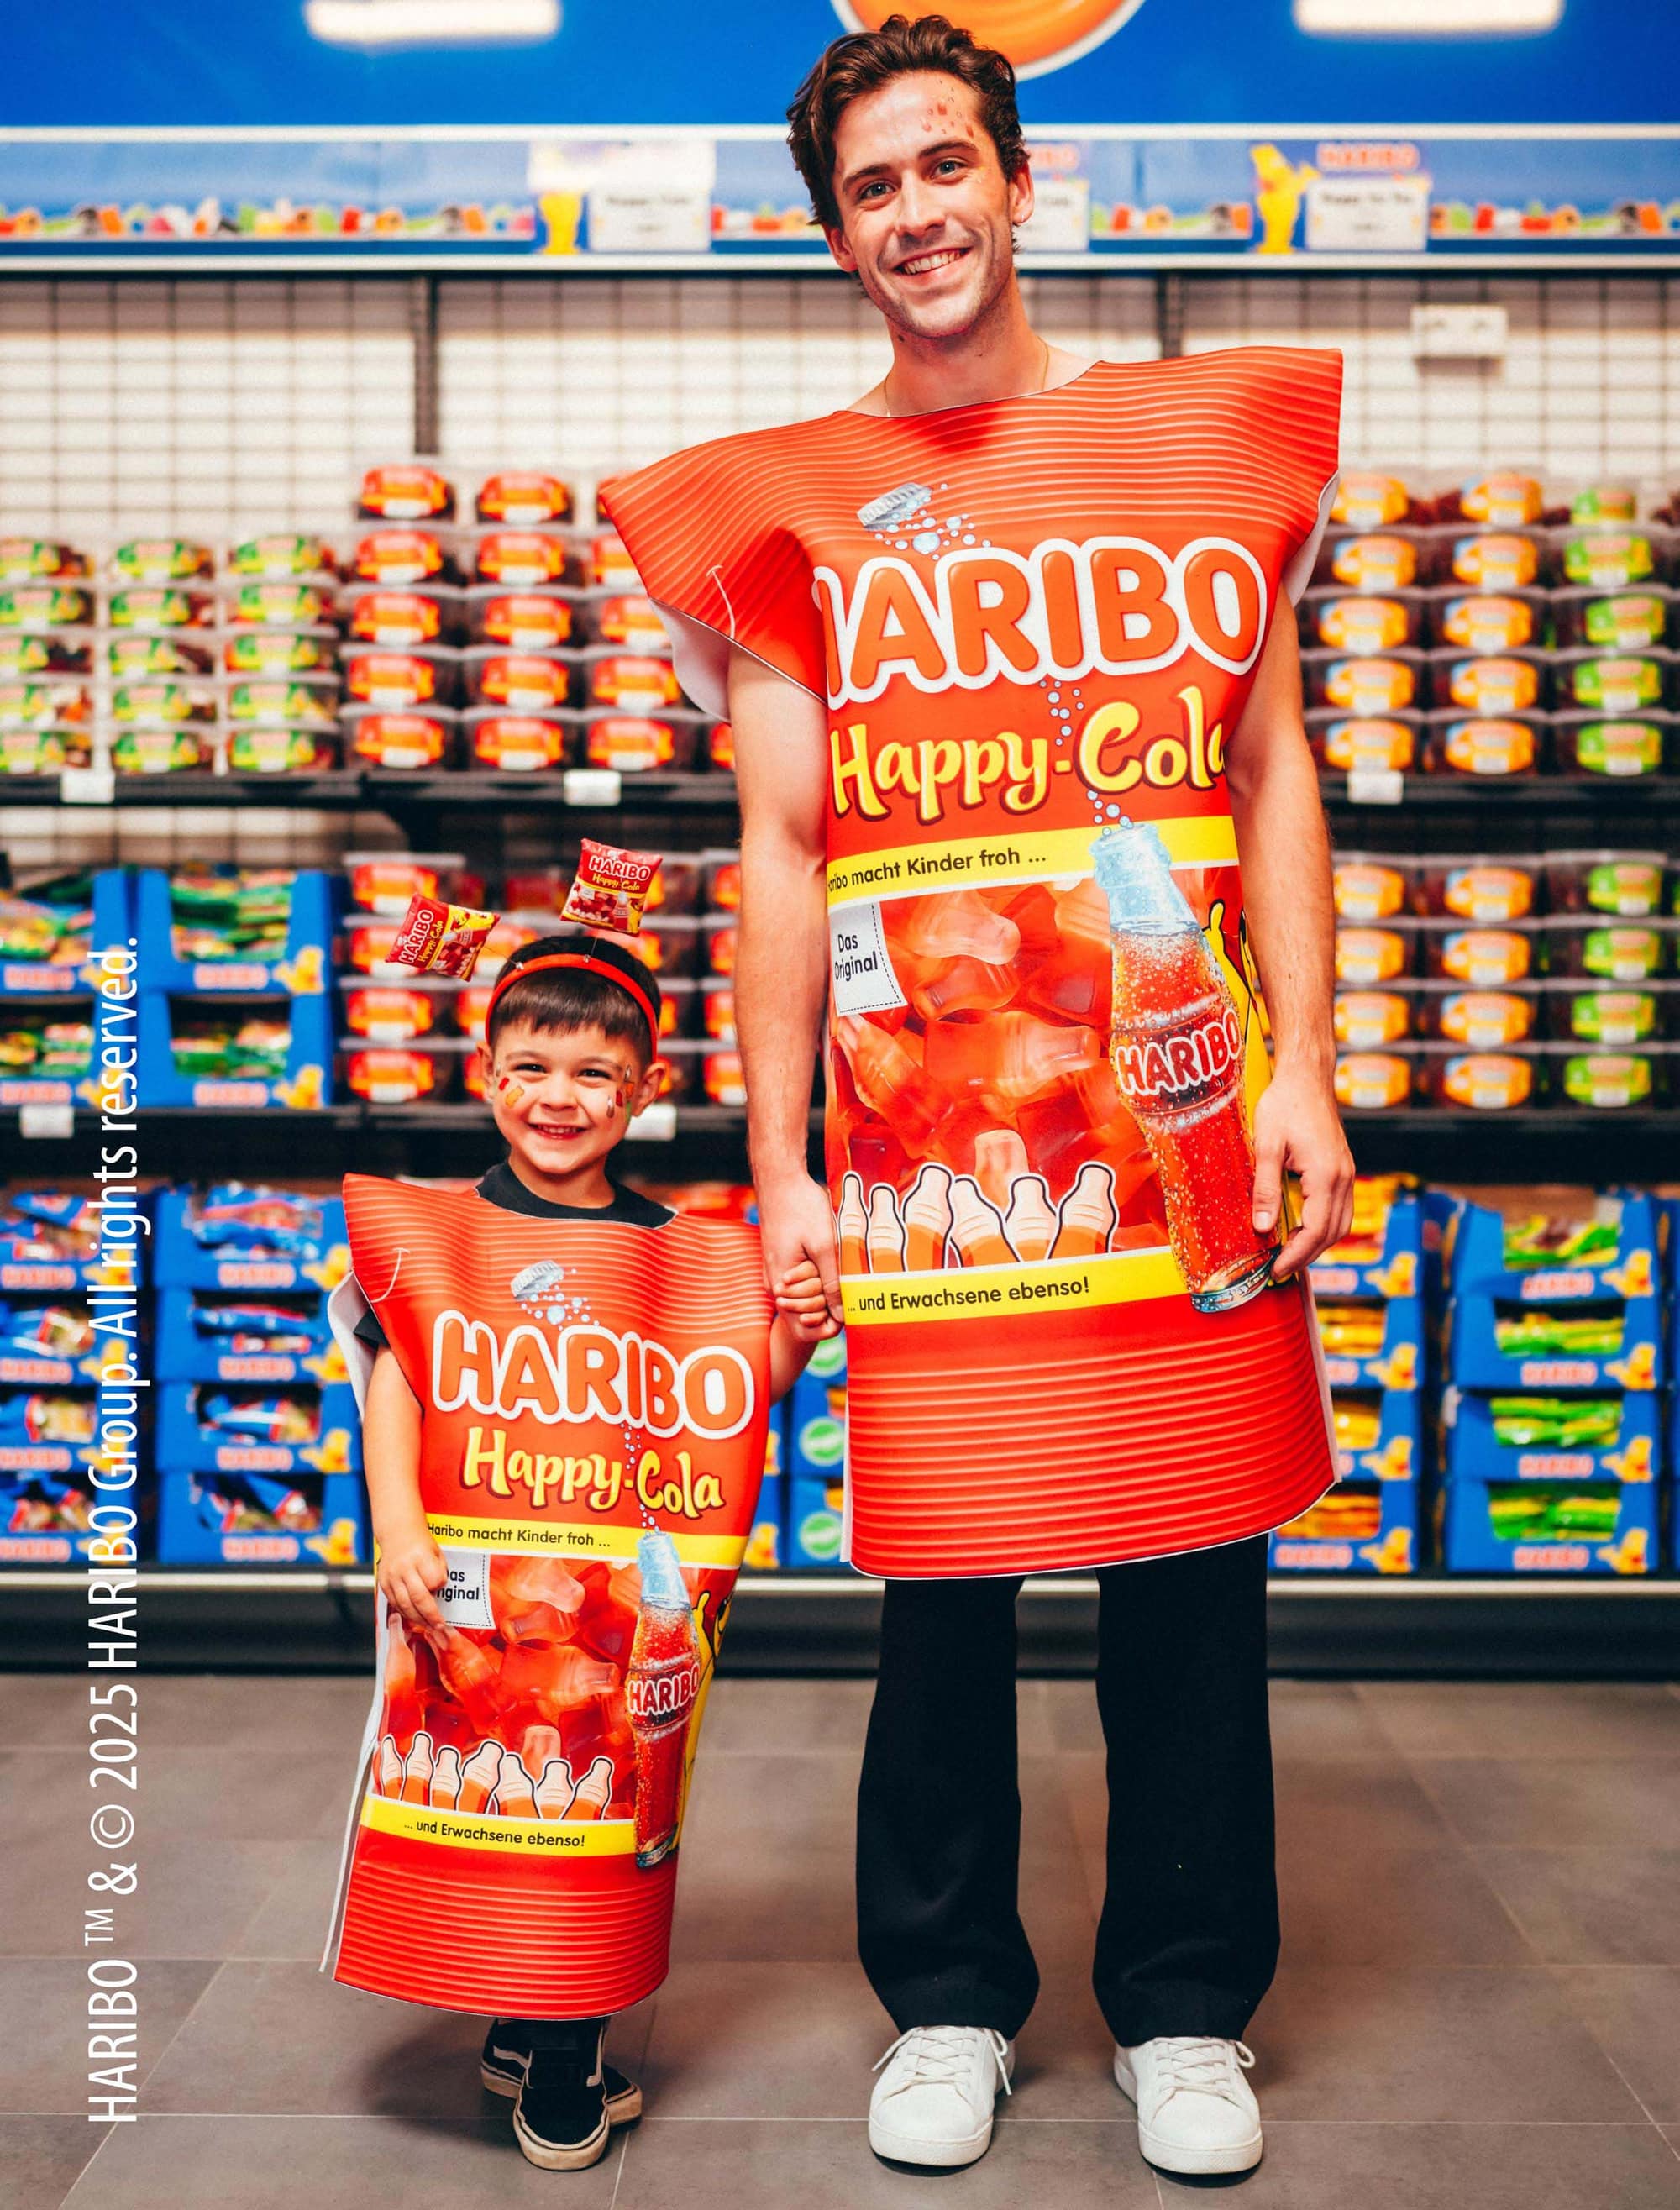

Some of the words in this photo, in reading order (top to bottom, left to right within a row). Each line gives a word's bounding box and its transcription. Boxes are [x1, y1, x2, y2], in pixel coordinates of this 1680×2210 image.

[589, 855, 651, 881] HARIBO
[851, 861, 900, 886] macht
[907, 853, 974, 876] Kinder
[979, 847, 1020, 868] froh
[398, 909, 434, 964] HARIBO
[837, 933, 858, 953] Das
[834, 950, 878, 982] Original
[1116, 1008, 1242, 1096] HARIBO
[859, 1292, 885, 1311] und
[891, 1288, 1001, 1310] Erwachsene
[1008, 1276, 1089, 1300] ebenso!
[433, 1309, 754, 1440] HARIBO
[462, 1427, 724, 1519] Happy-Cola
[427, 1522, 464, 1538] Haribo
[468, 1527, 512, 1541] macht
[517, 1529, 563, 1544] Kinder
[567, 1531, 595, 1546] froh
[446, 1569, 465, 1583] as
[627, 1661, 701, 1717] HARIBO
[417, 1821, 437, 1834] und
[442, 1823, 522, 1844] Erwachsene
[528, 1832, 585, 1847] ebenso!
